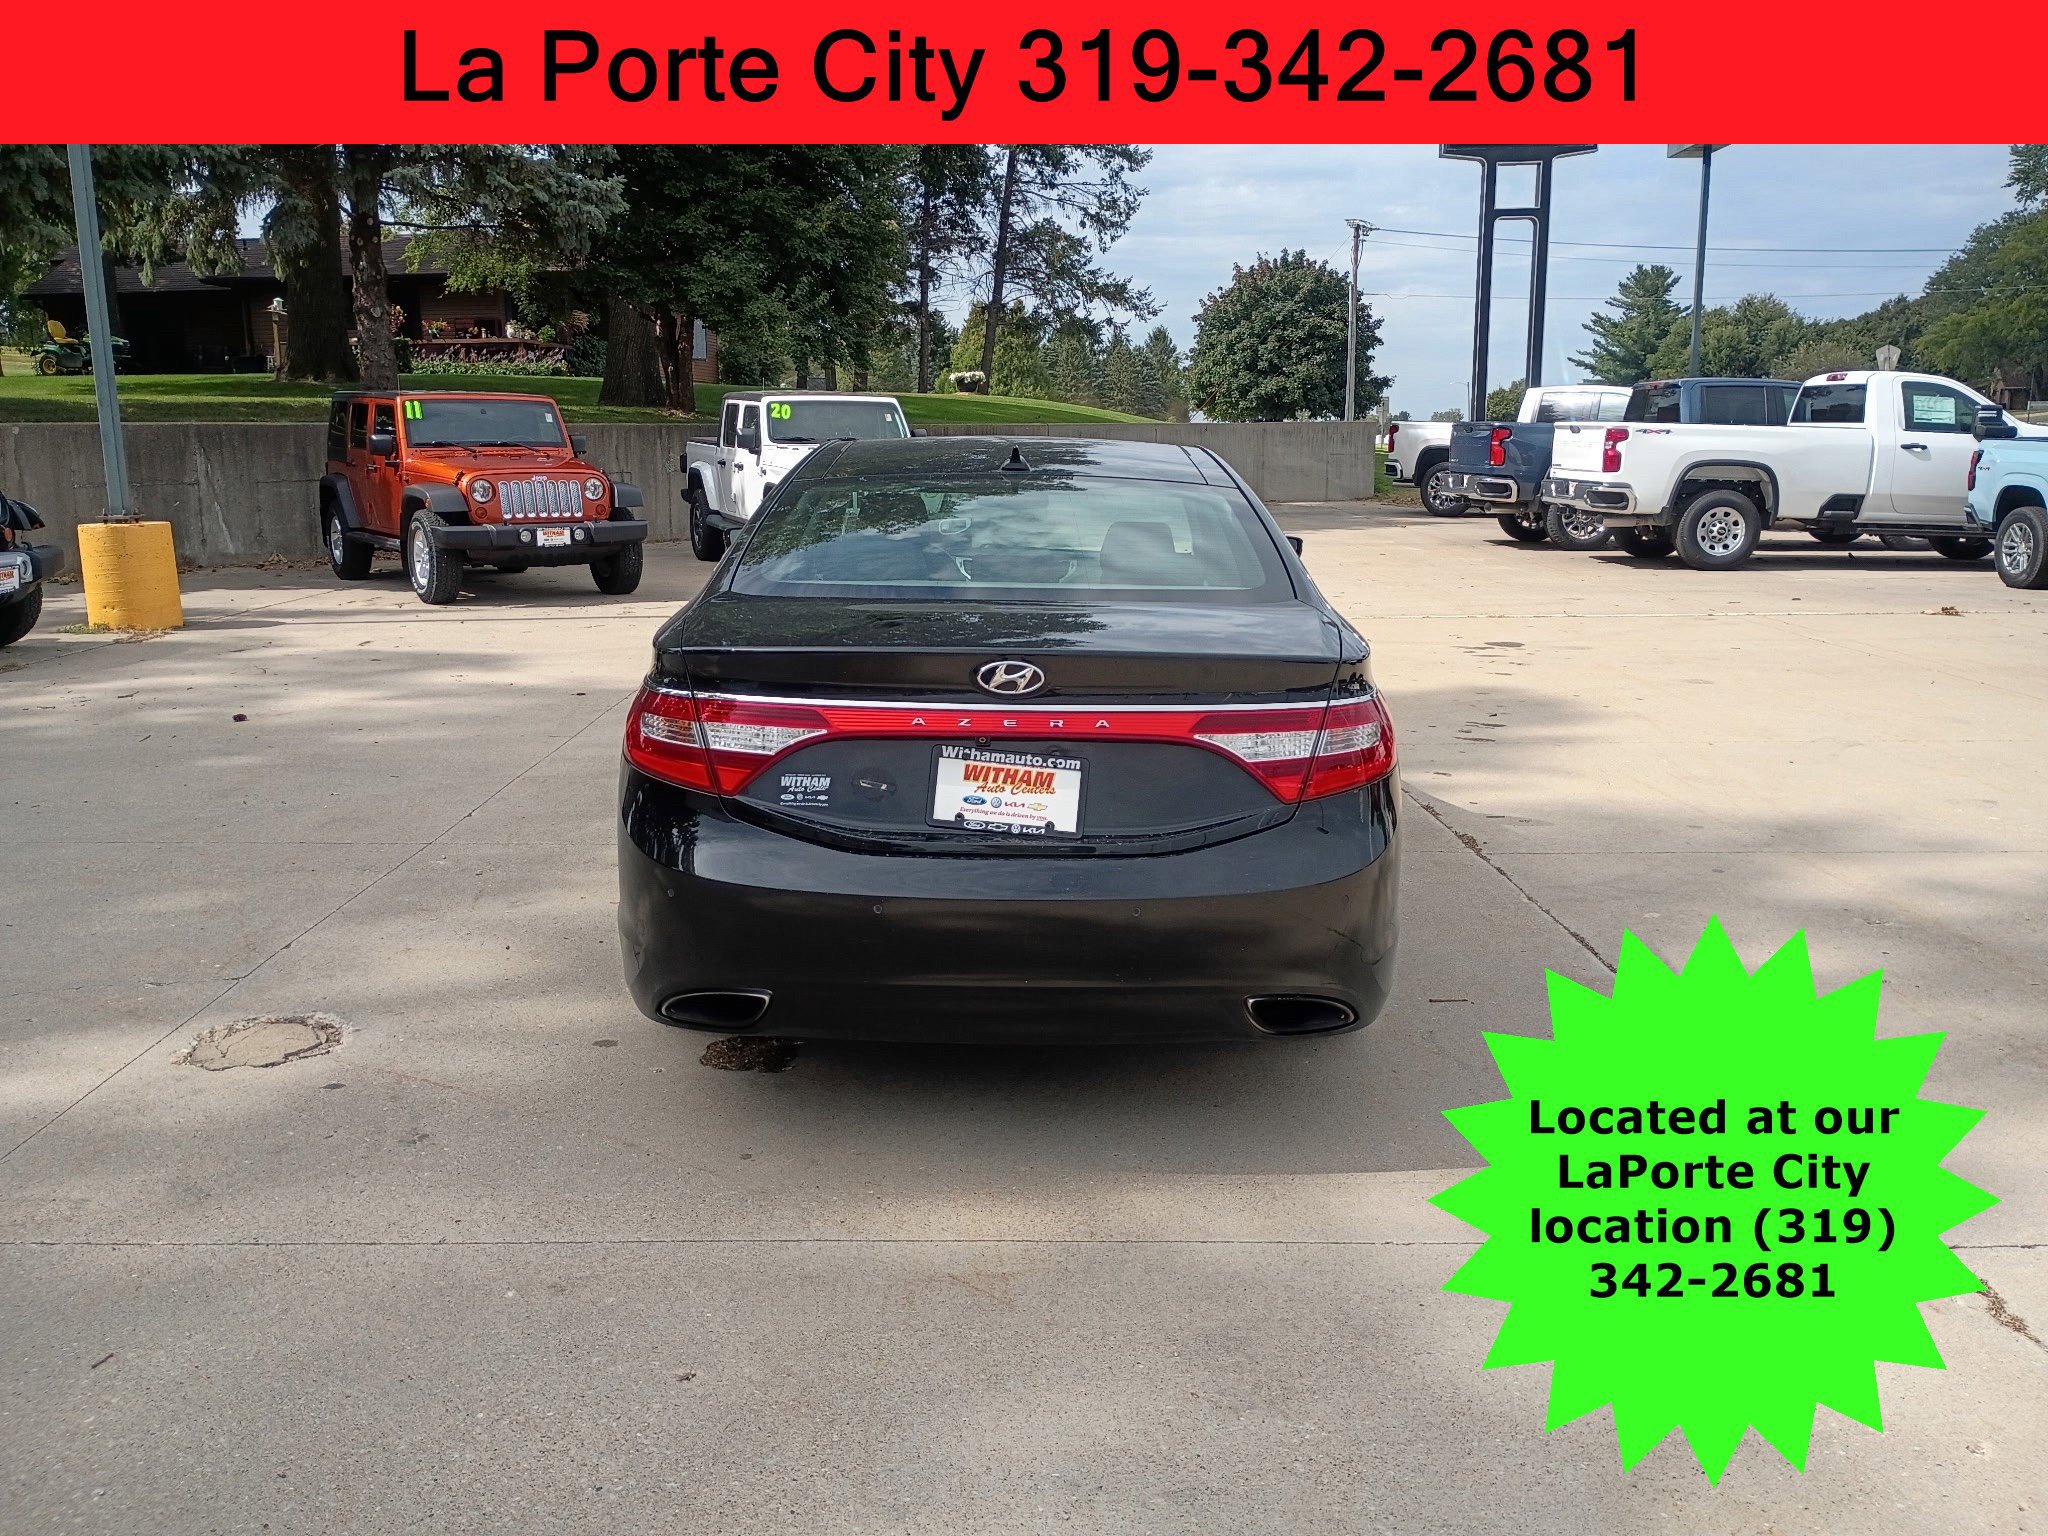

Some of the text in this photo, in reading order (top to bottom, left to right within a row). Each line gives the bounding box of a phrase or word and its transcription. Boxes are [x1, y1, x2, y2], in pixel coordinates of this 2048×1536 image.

[405, 401, 423, 420] 11
[770, 403, 791, 420] 20
[911, 717, 1110, 728] AZERA
[780, 776, 831, 787] WITHAM
[963, 763, 1056, 789] WITHAM
[974, 781, 1057, 796] Auto Centers
[960, 806, 990, 816] Everything
[1010, 811, 1029, 819] driven
